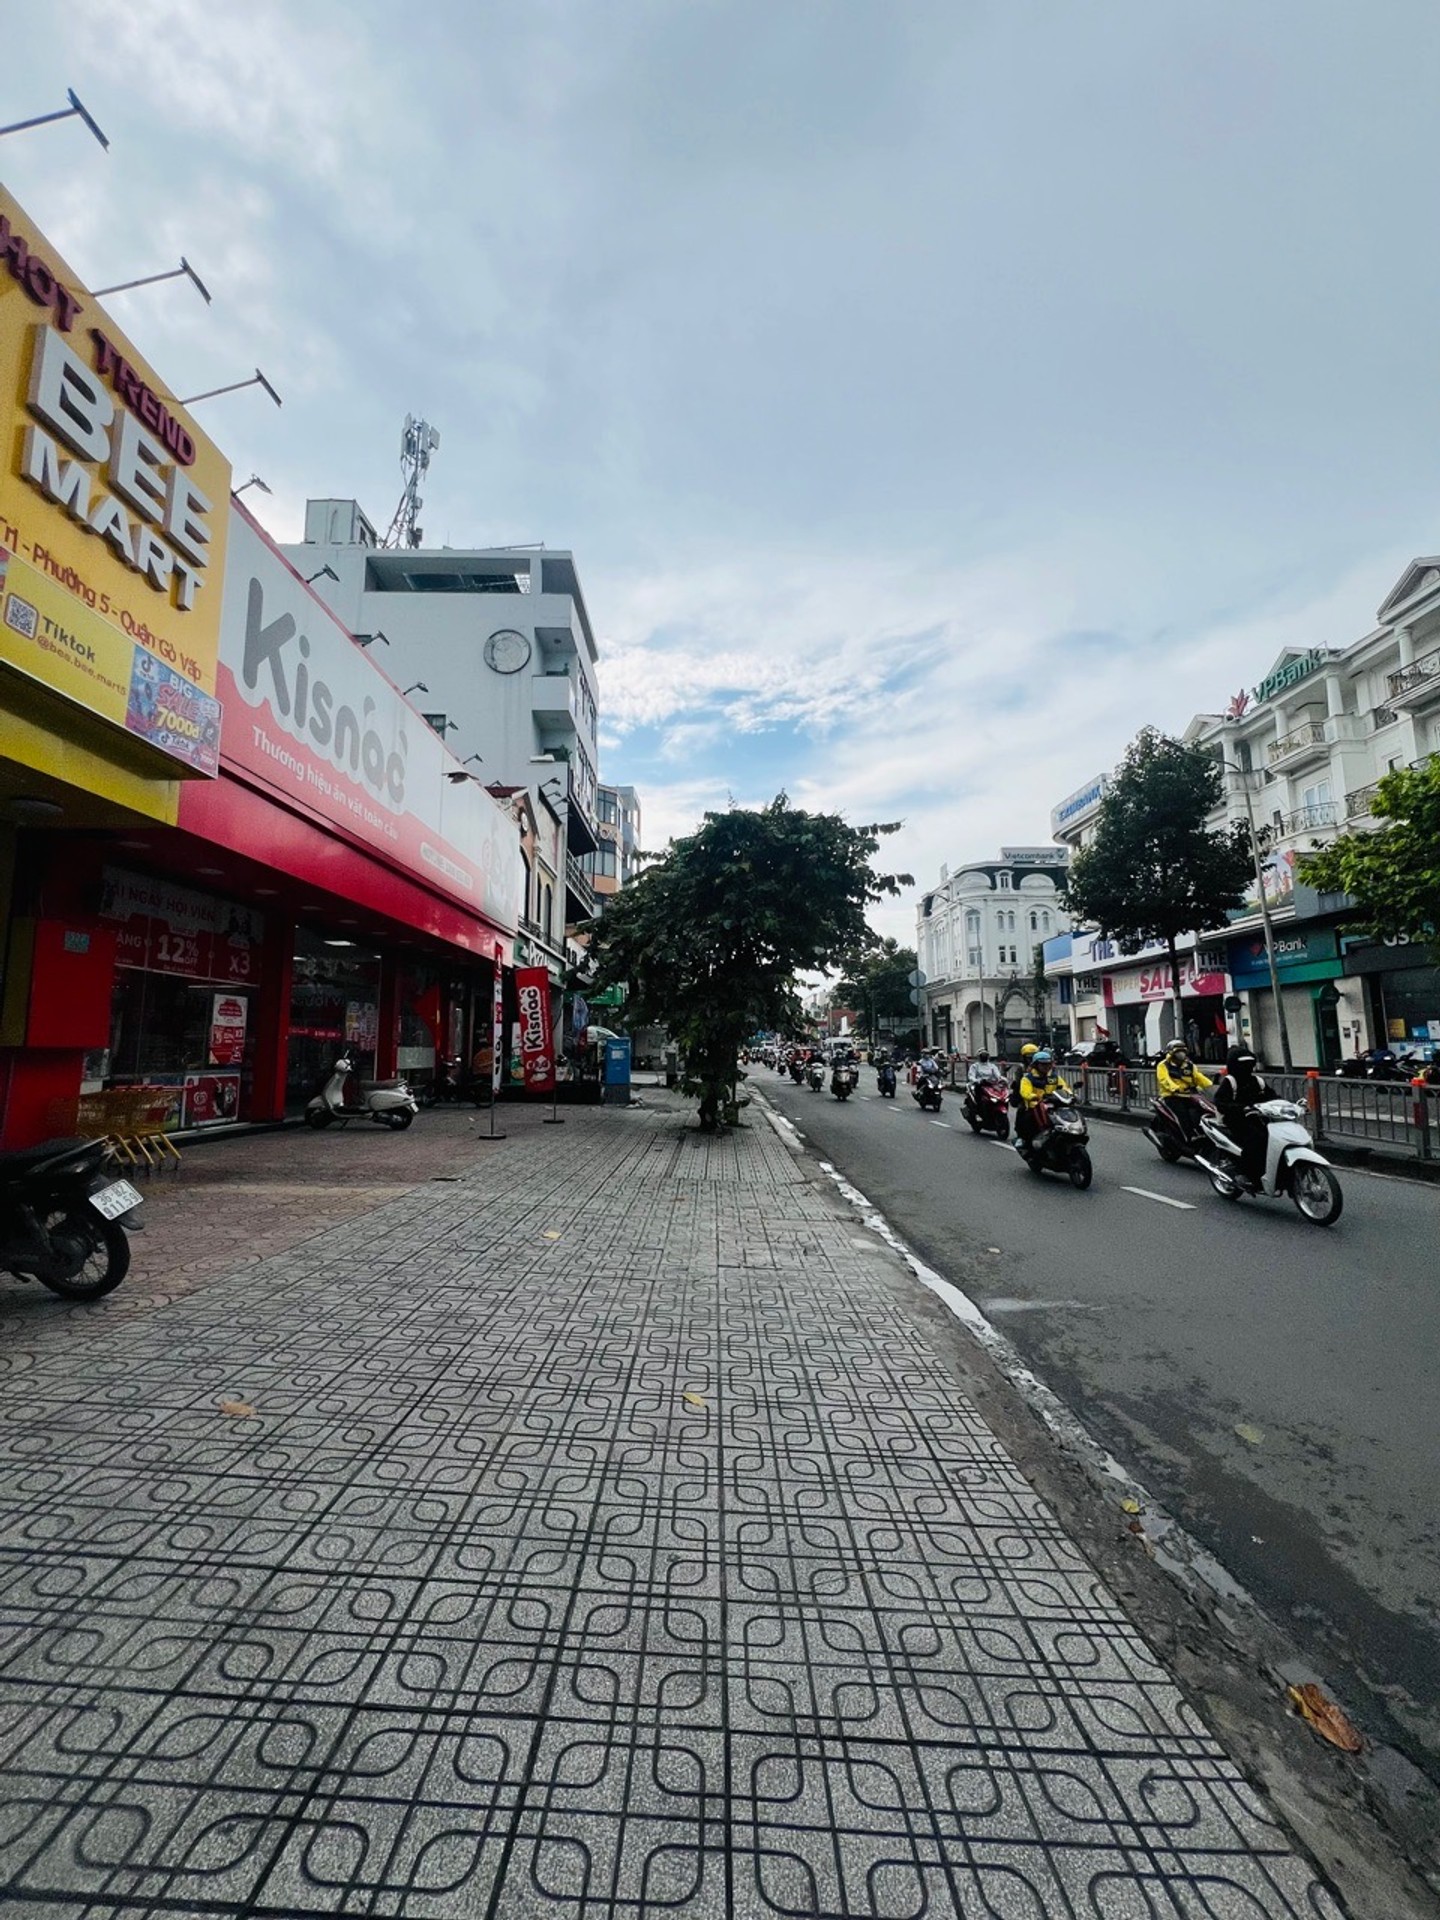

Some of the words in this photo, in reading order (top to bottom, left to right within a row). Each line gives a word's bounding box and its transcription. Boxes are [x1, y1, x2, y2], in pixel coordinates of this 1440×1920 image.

[87, 327, 196, 466] TREND
[30, 323, 214, 567] BEE
[22, 424, 206, 611] MART
[31, 543, 96, 608] Phường
[99, 592, 111, 616] 5
[121, 610, 155, 648] Quận
[159, 639, 176, 662] Gò
[180, 652, 201, 683] Vấp
[42, 616, 95, 663] Tiktok
[169, 673, 192, 698] BIG
[1252, 649, 1321, 704] VPBank
[157, 682, 201, 719] SALE
[252, 725, 304, 782] Thương
[307, 764, 331, 795] hiệu
[334, 784, 346, 804] ăn
[348, 798, 361, 817] vặt
[364, 807, 383, 828] toàn
[1004, 852, 1054, 860] Vietcombank
[1091, 940, 1114, 962] THE
[1198, 952, 1226, 966] THE
[1077, 977, 1098, 988] THE
[1113, 976, 1139, 993] SUPER
[1140, 965, 1185, 993] SALE
